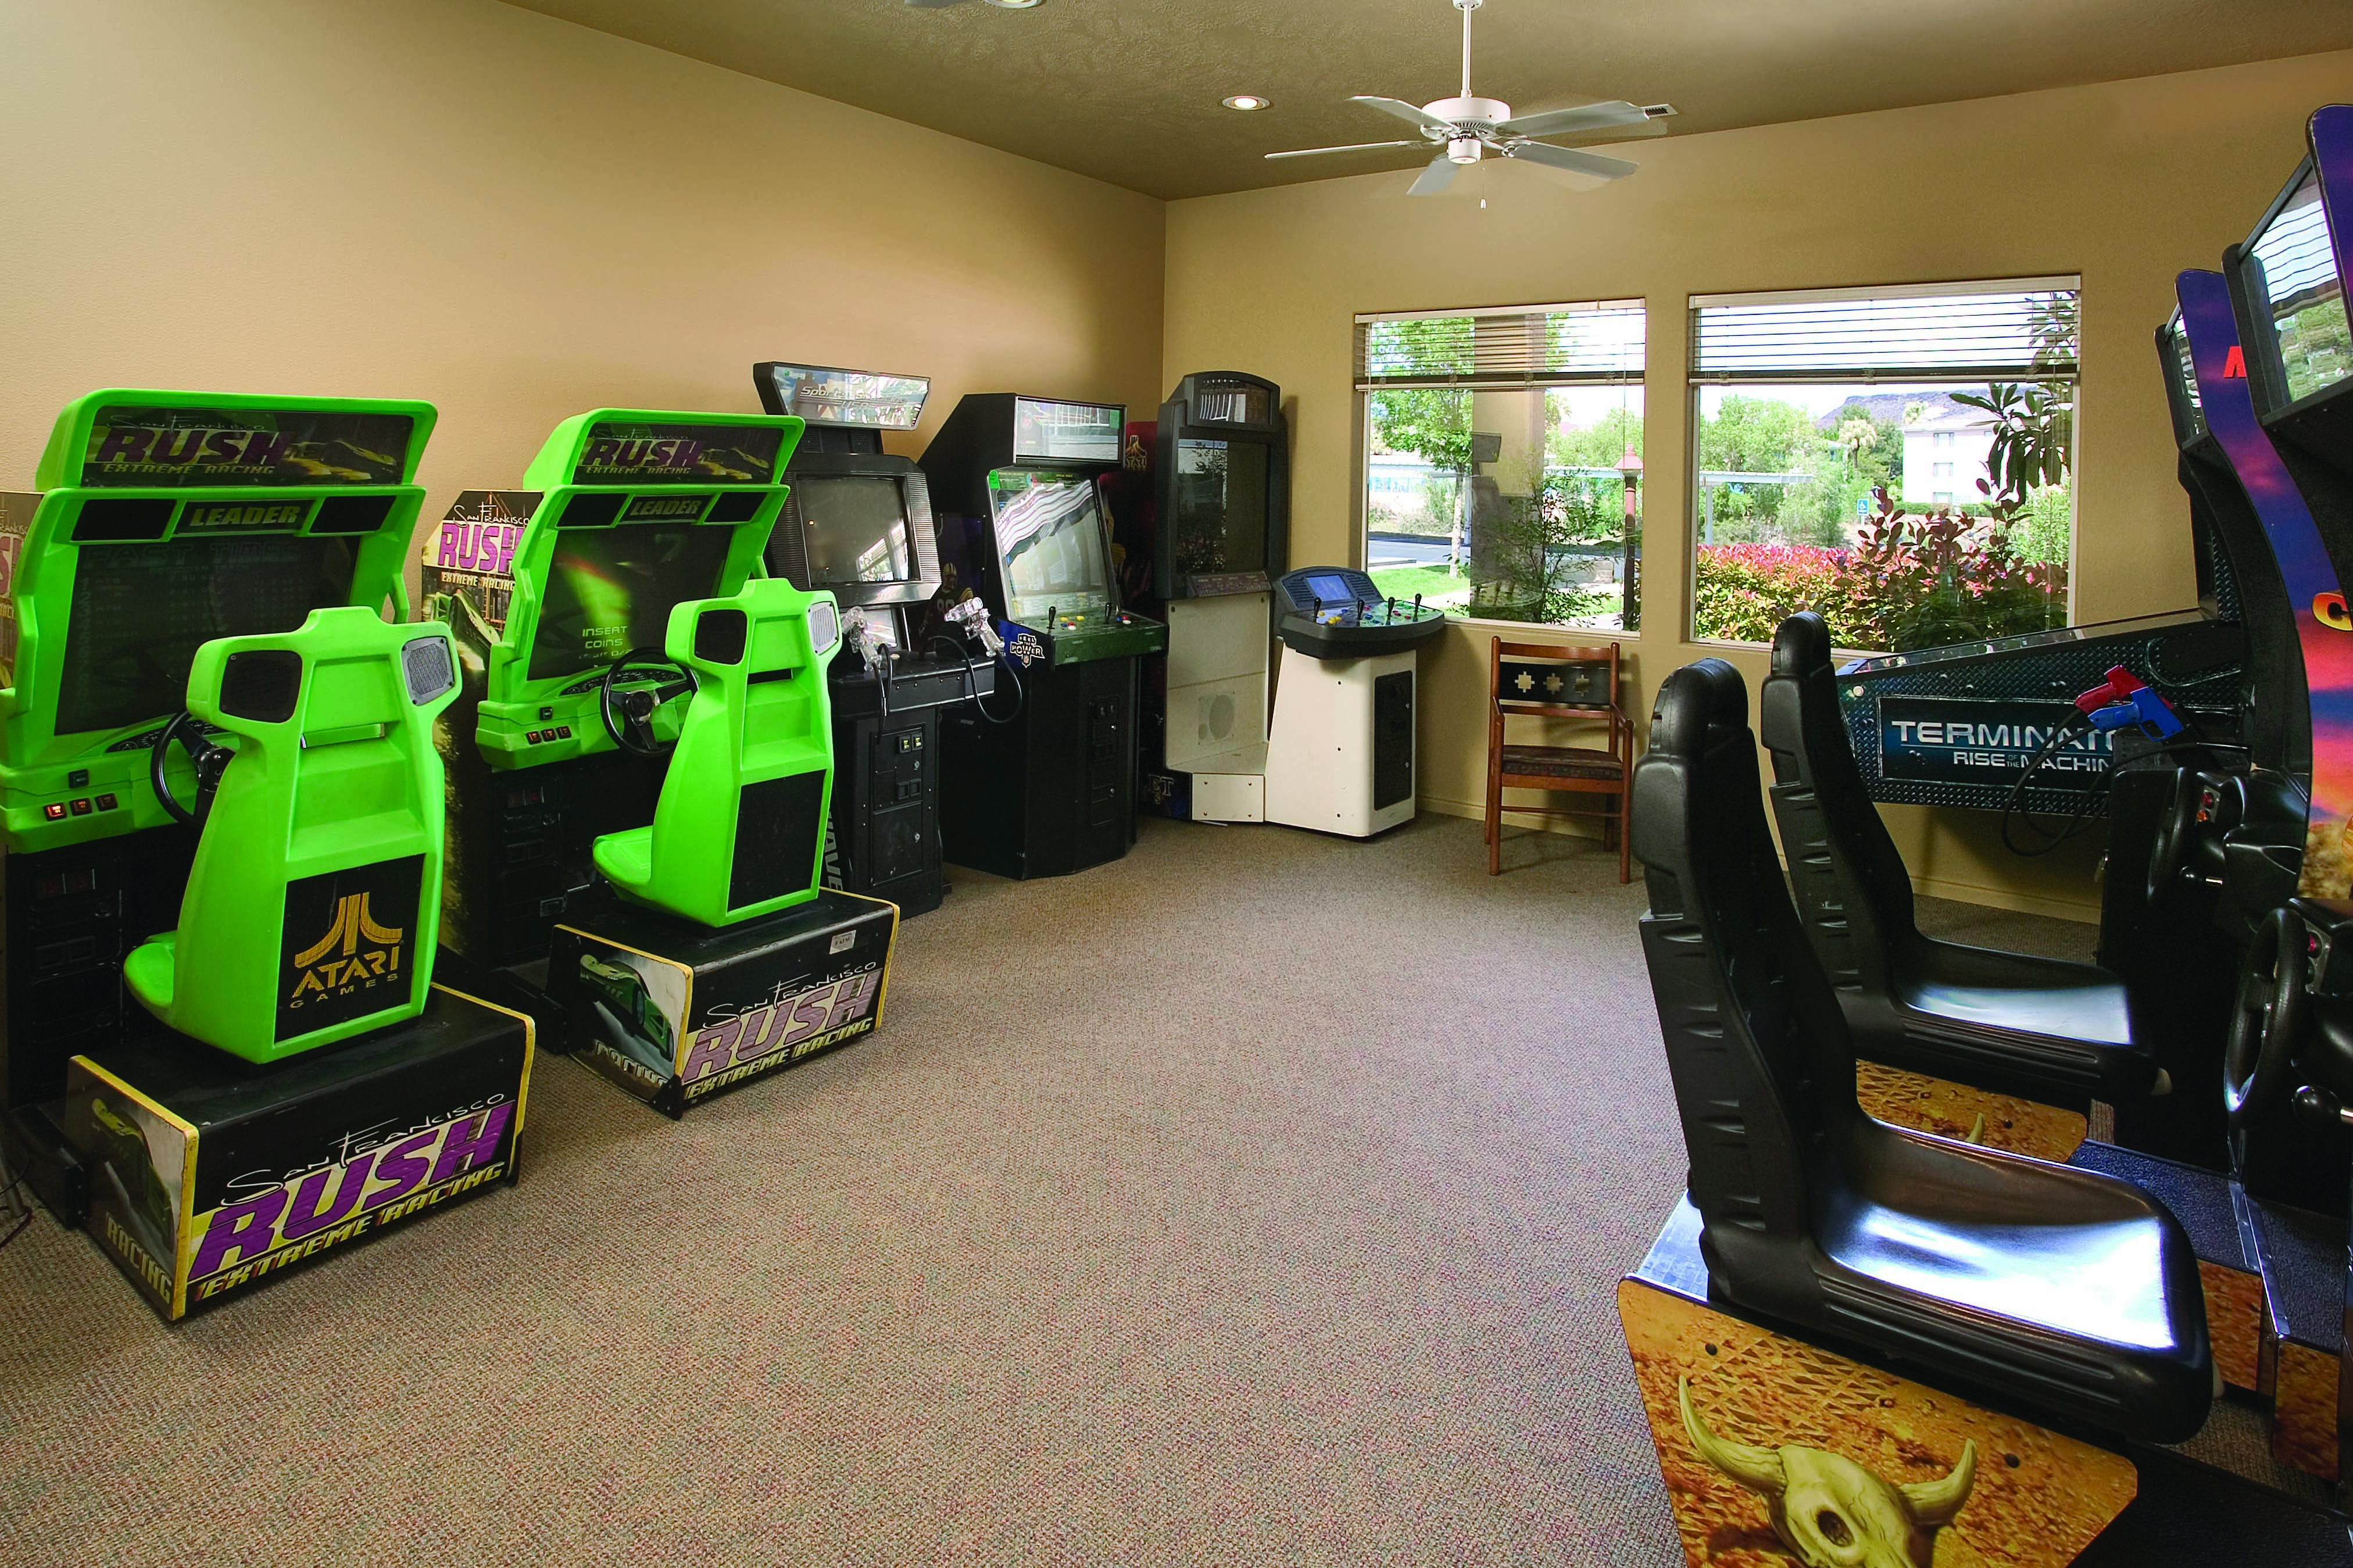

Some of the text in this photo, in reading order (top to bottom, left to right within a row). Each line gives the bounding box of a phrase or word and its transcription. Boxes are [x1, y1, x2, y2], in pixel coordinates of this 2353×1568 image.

[95, 431, 294, 465] RUSH
[582, 441, 705, 467] RUSH
[103, 464, 275, 475] EXTREME RACING
[191, 506, 301, 526] LEADER
[630, 500, 702, 516] LEADER
[438, 523, 525, 573] RUSH
[442, 572, 478, 586] EXTREME
[582, 626, 628, 638] INSERT
[585, 638, 624, 649] COINS
[1011, 645, 1040, 656] POWER
[1953, 751, 2005, 767] RISE
[292, 946, 400, 998] ATARI
[290, 973, 399, 1008] GAMES
[681, 968, 883, 1083] RUSH
[686, 1017, 873, 1100] EXTREME RACING
[188, 1100, 515, 1279] RUSH
[201, 1161, 506, 1299] EXTREME RACING
[106, 1212, 171, 1304] RACING
